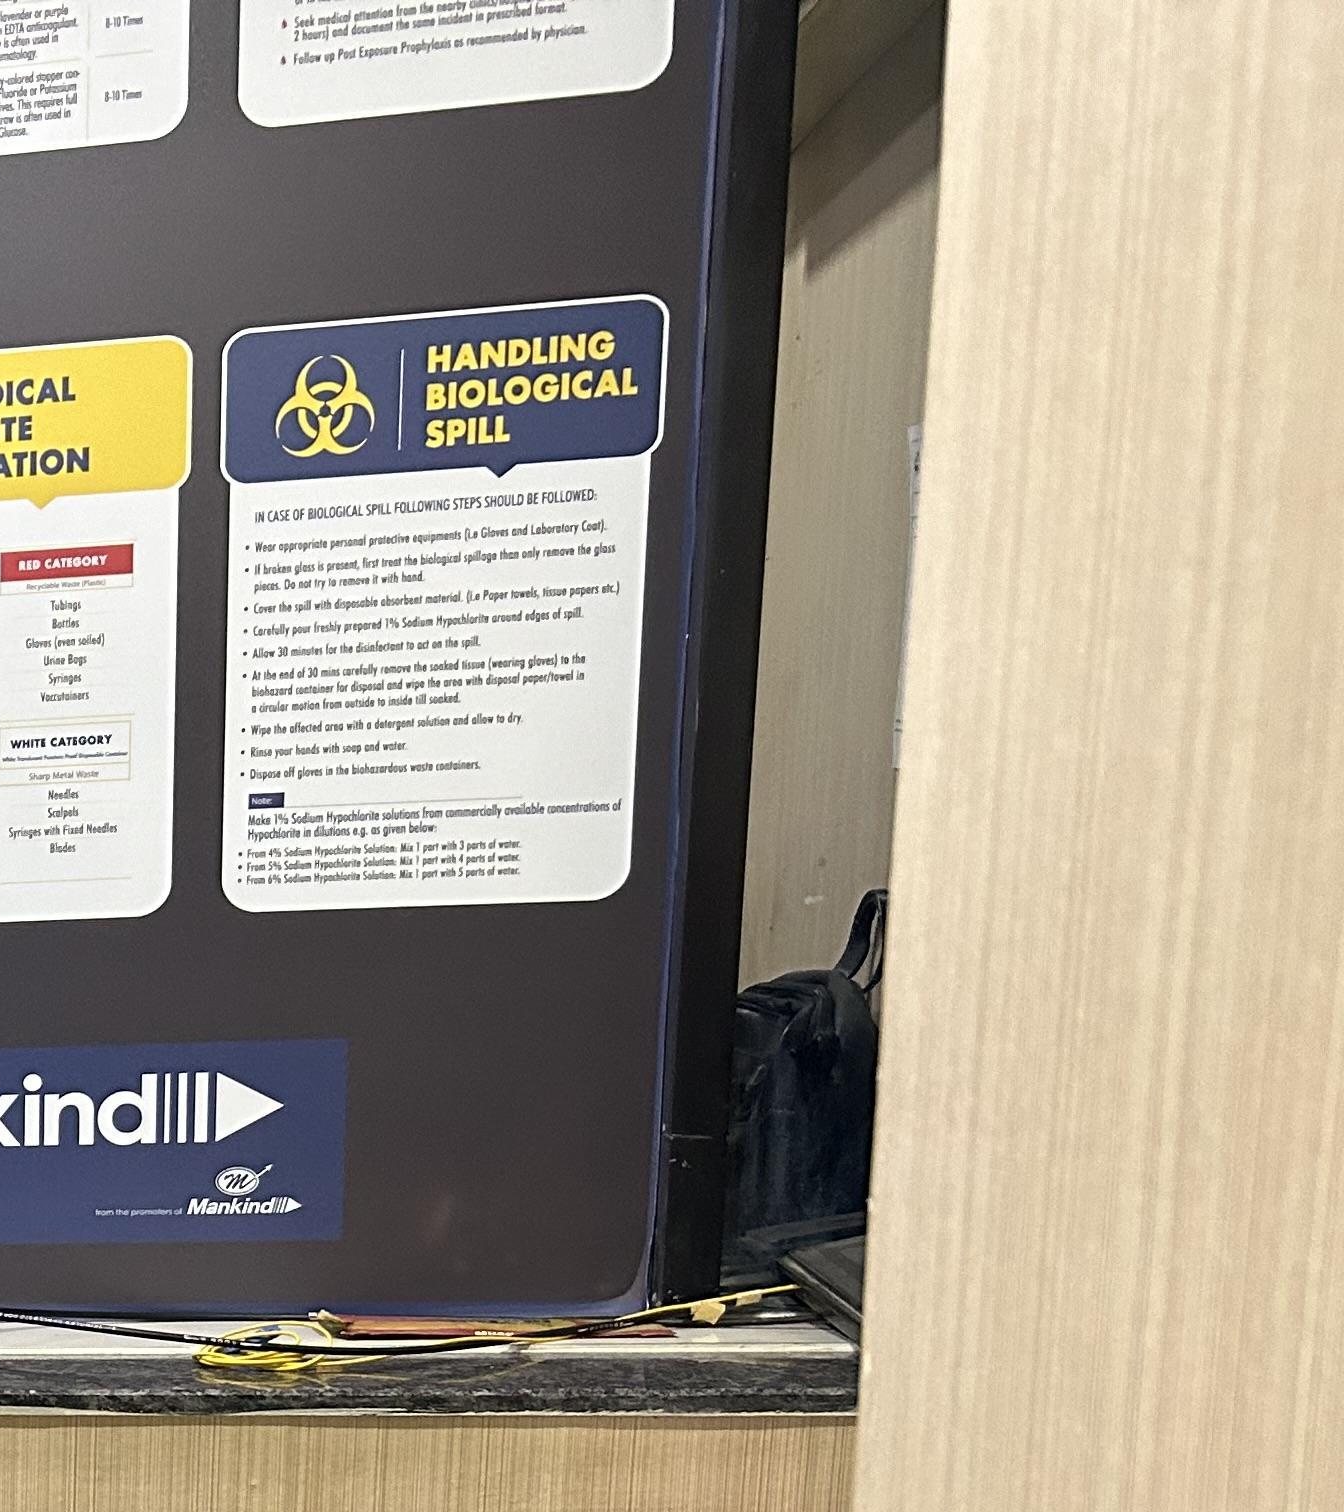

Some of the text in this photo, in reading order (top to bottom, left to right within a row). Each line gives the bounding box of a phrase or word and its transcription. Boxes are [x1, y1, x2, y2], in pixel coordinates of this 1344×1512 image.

[425, 331, 615, 374] HANDLING
[425, 367, 638, 411] BIOLOGICAL
[425, 417, 510, 448] SPILL
[255, 488, 597, 523] IN CASE OF BIOLOGICAL SPILL FOLLOWING STEPS SHOULD BE FOLLOWED:
[18, 555, 107, 571] RED CATEGORY
[50, 600, 81, 611] Tubings
[52, 617, 79, 629] Bottles
[26, 633, 105, 649] Gloves (even soiled)
[44, 654, 87, 666] Urine Bags
[48, 673, 82, 685] Syringes
[11, 734, 112, 748] WHITE CATEGORY
[48, 789, 79, 800] Needles
[48, 807, 78, 819] Scalpels
[9, 822, 117, 840] Syringes with Fixed Needles
[50, 843, 76, 853] Blades
[187, 1197, 273, 1215] Mankind
